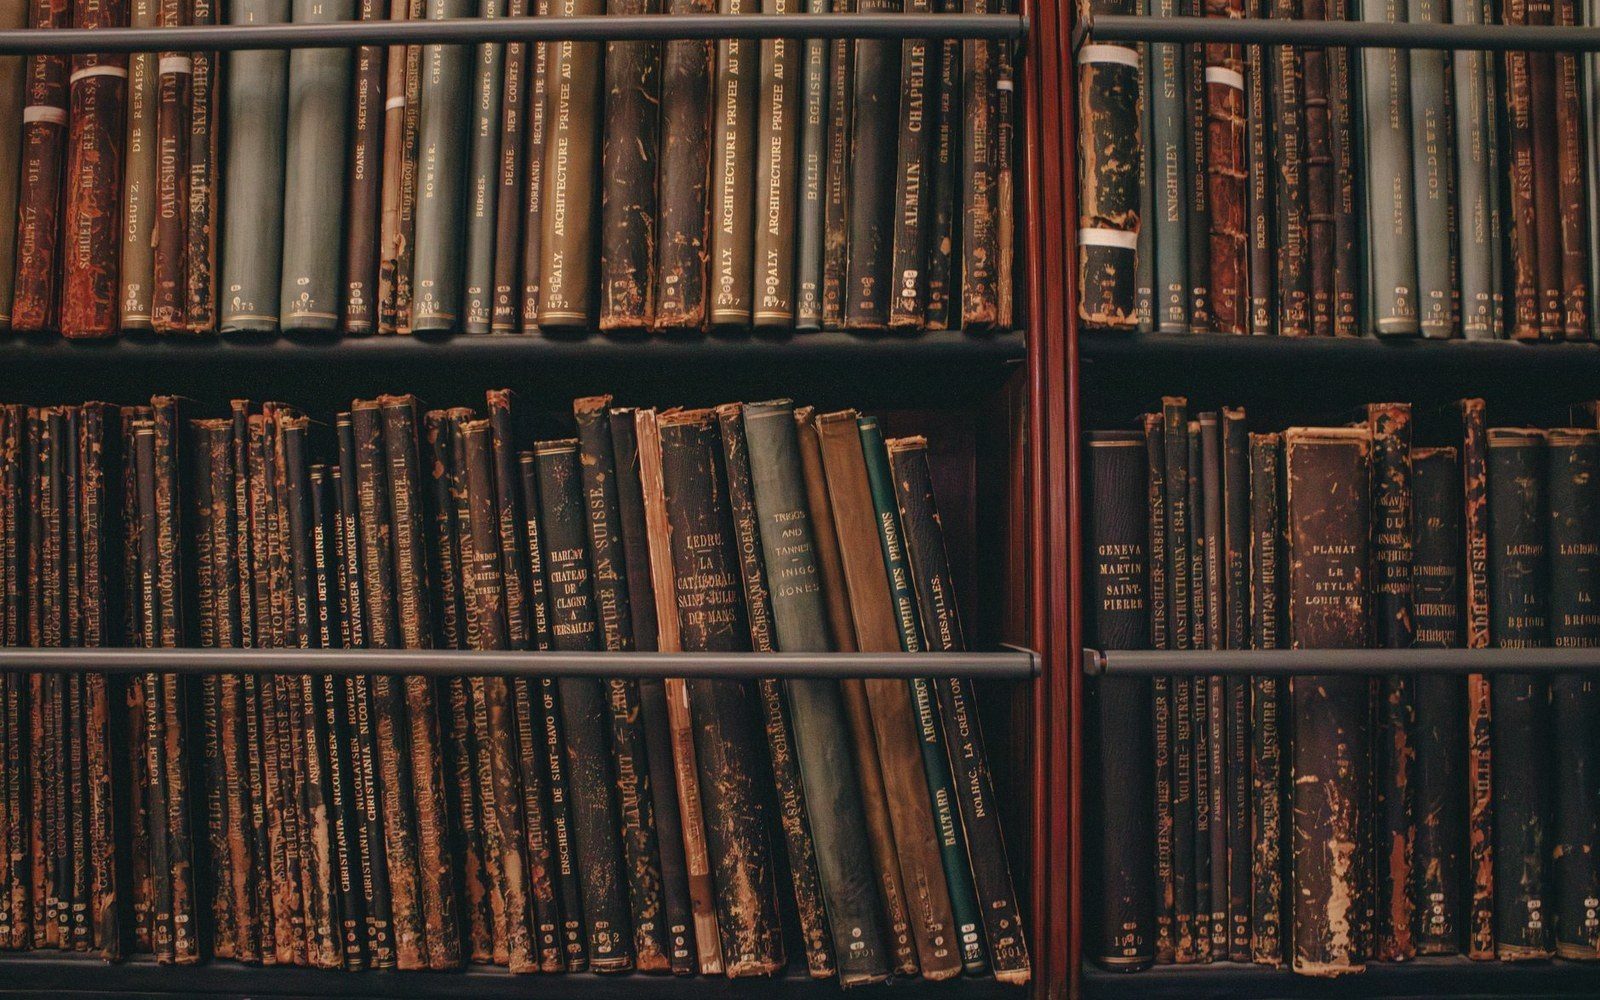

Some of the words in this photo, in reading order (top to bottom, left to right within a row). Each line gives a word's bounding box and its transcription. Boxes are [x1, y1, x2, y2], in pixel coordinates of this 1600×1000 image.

[539, 1, 548, 15] DE
[360, 59, 369, 70] IN
[562, 63, 571, 78] AU
[729, 59, 739, 74] AU
[773, 64, 783, 79] AU
[812, 46, 821, 64] DE
[1163, 45, 1175, 98] STABLE
[508, 61, 519, 102] COURTS
[536, 78, 544, 93] DE
[908, 46, 924, 132] CHAPELLE
[357, 79, 368, 130] SKETCHES
[507, 109, 516, 132] NEW
[533, 100, 544, 144] RECUEIL
[559, 83, 570, 130] PRIVEE
[727, 81, 738, 125] PRIVEE
[772, 84, 783, 131] PRIVEE
[131, 129, 141, 152] DIE
[476, 175, 485, 217] BURGES.
[482, 72, 491, 109] COURTS
[426, 143, 436, 198] BOWLER.
[505, 146, 515, 185] DEANE.
[530, 157, 540, 212] NORMAND.
[724, 132, 736, 233] ARCHITECTURE
[769, 137, 781, 234] ARCHITECTURE
[807, 152, 818, 200] BALLU.
[1166, 142, 1179, 222] KNIGHTLEY
[555, 138, 568, 236] ARCHITECTURE
[905, 159, 921, 227] ALMAIN.
[314, 522, 325, 568] RUINER.
[333, 509, 344, 557] RUINER.
[345, 513, 358, 574] DOMKIRKE.
[527, 516, 542, 573] HAARLEM.
[782, 527, 803, 538] AND
[882, 512, 901, 561] PRISONS
[1098, 545, 1141, 557] GENEVA
[1312, 545, 1356, 555] PLANAT
[337, 564, 347, 591] DETS
[700, 557, 713, 570] LA
[781, 565, 815, 578] INIGO
[893, 568, 907, 590] DES
[1100, 564, 1141, 575] MARTIN
[317, 573, 327, 601] DETS
[339, 598, 348, 613] OG
[533, 579, 543, 594] TE
[557, 596, 587, 608] CLAGNY
[565, 583, 576, 595] DE
[1103, 598, 1144, 611] PIERRE
[297, 592, 307, 624] SLOT.
[319, 606, 327, 621] OG
[349, 580, 363, 645] STAVANGER
[536, 602, 547, 633] KERK
[931, 573, 953, 649] VERSAILLES.
[147, 673, 157, 738] TRAVELLIN
[326, 708, 335, 725] OM
[544, 693, 554, 709] OF
[150, 747, 159, 784] ROTCH
[306, 725, 319, 785] ANDERSEN.
[328, 730, 342, 805] NICOLAYSEN.
[545, 715, 560, 780] SINT-BAVO
[963, 743, 974, 759] LA
[350, 734, 365, 810] NICOLAYSEN.
[363, 742, 376, 821] CHRISTIANIA.
[968, 767, 986, 817] NOLHAC.
[553, 787, 563, 803] DE
[935, 786, 956, 846] BALTARD.
[336, 815, 351, 892] CHRISTIANIA.
[359, 822, 374, 900] CHRISTIANIA.
